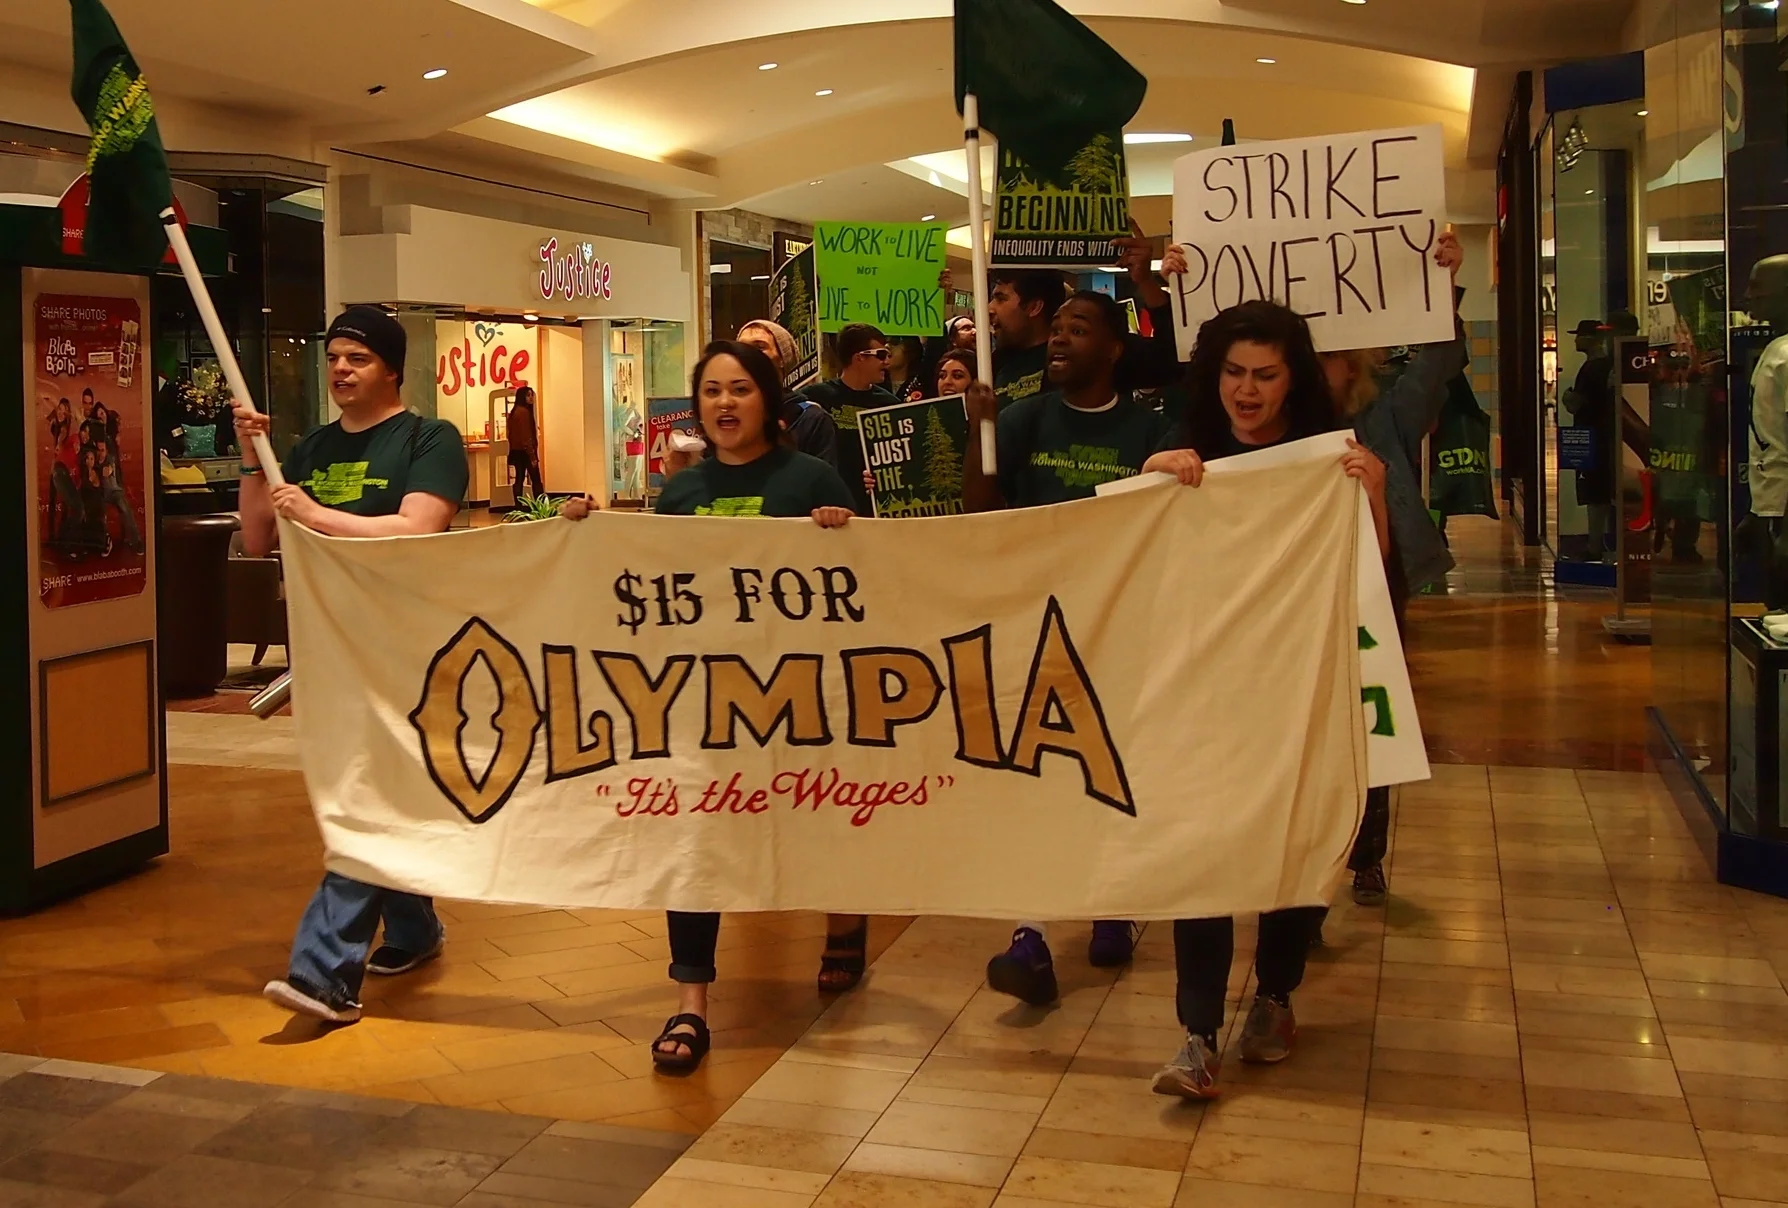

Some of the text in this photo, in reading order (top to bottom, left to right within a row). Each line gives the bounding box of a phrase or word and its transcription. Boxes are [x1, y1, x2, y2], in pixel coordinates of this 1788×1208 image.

[1203, 136, 1422, 222] STRIKE
[62, 227, 84, 239] SHARE
[819, 226, 883, 256] WORK
[895, 227, 942, 263] LIVE
[993, 239, 1054, 257] INEQUALITY
[1056, 240, 1084, 257] ENDS
[540, 237, 611, 301] Justice
[856, 265, 879, 276] NOT
[1177, 219, 1435, 327] POVERTY
[41, 306, 107, 321] SHARE PHOTOS
[857, 300, 871, 310] TO
[875, 287, 941, 328] WORK
[436, 337, 530, 396] ustice
[651, 409, 694, 425] CLEARANC
[863, 412, 914, 440] $15 IS
[870, 437, 912, 466] JUST
[873, 466, 905, 493] THE
[1077, 461, 1139, 477] WASHINGTO
[43, 574, 72, 591] SHARE
[612, 565, 865, 636] $15 FOR
[408, 594, 1136, 824] OLYMPIA
[689, 771, 769, 815] the
